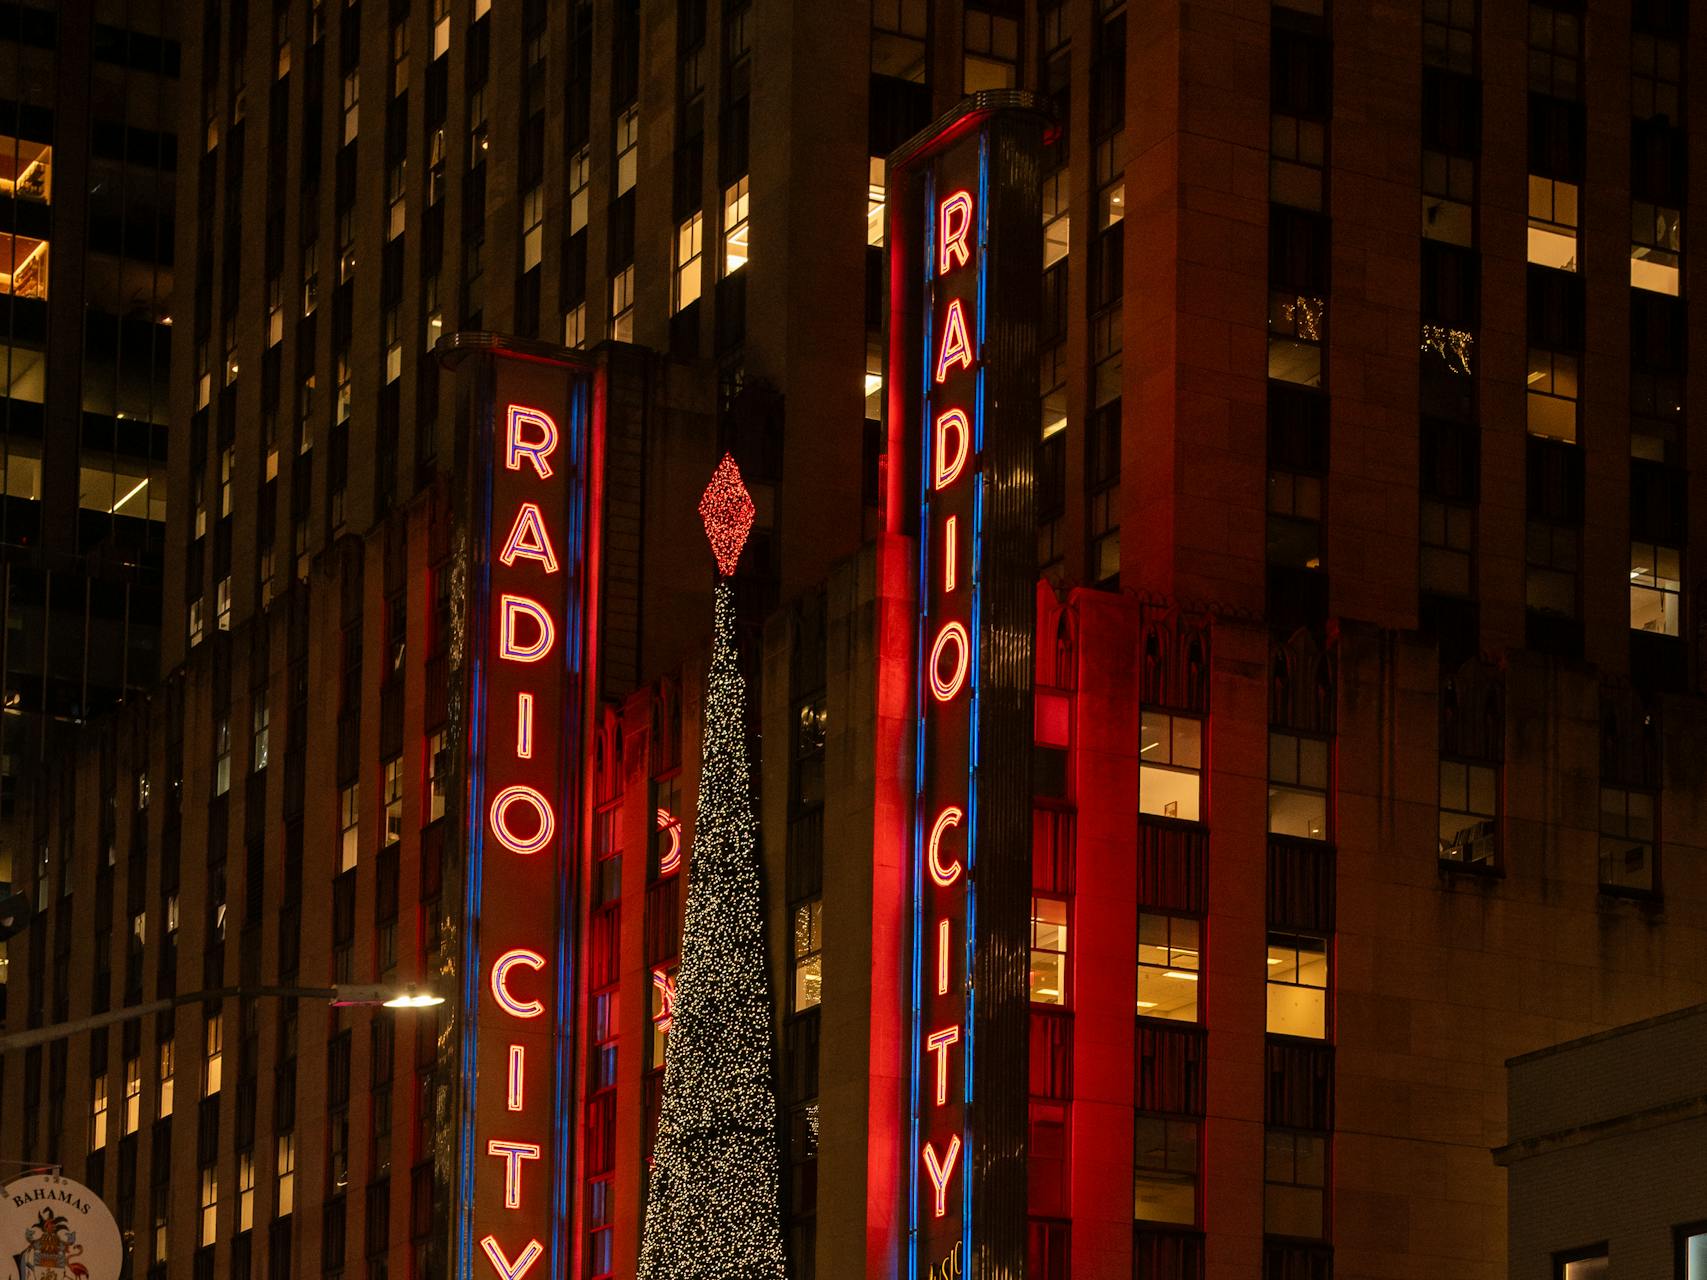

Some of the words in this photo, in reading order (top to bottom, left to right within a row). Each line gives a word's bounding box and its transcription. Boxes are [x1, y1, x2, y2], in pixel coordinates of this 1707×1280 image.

[489, 402, 561, 857] RADIO
[928, 188, 973, 703] RADIO
[12, 1188, 92, 1215] BAHAMAS
[921, 804, 963, 1219] CITY
